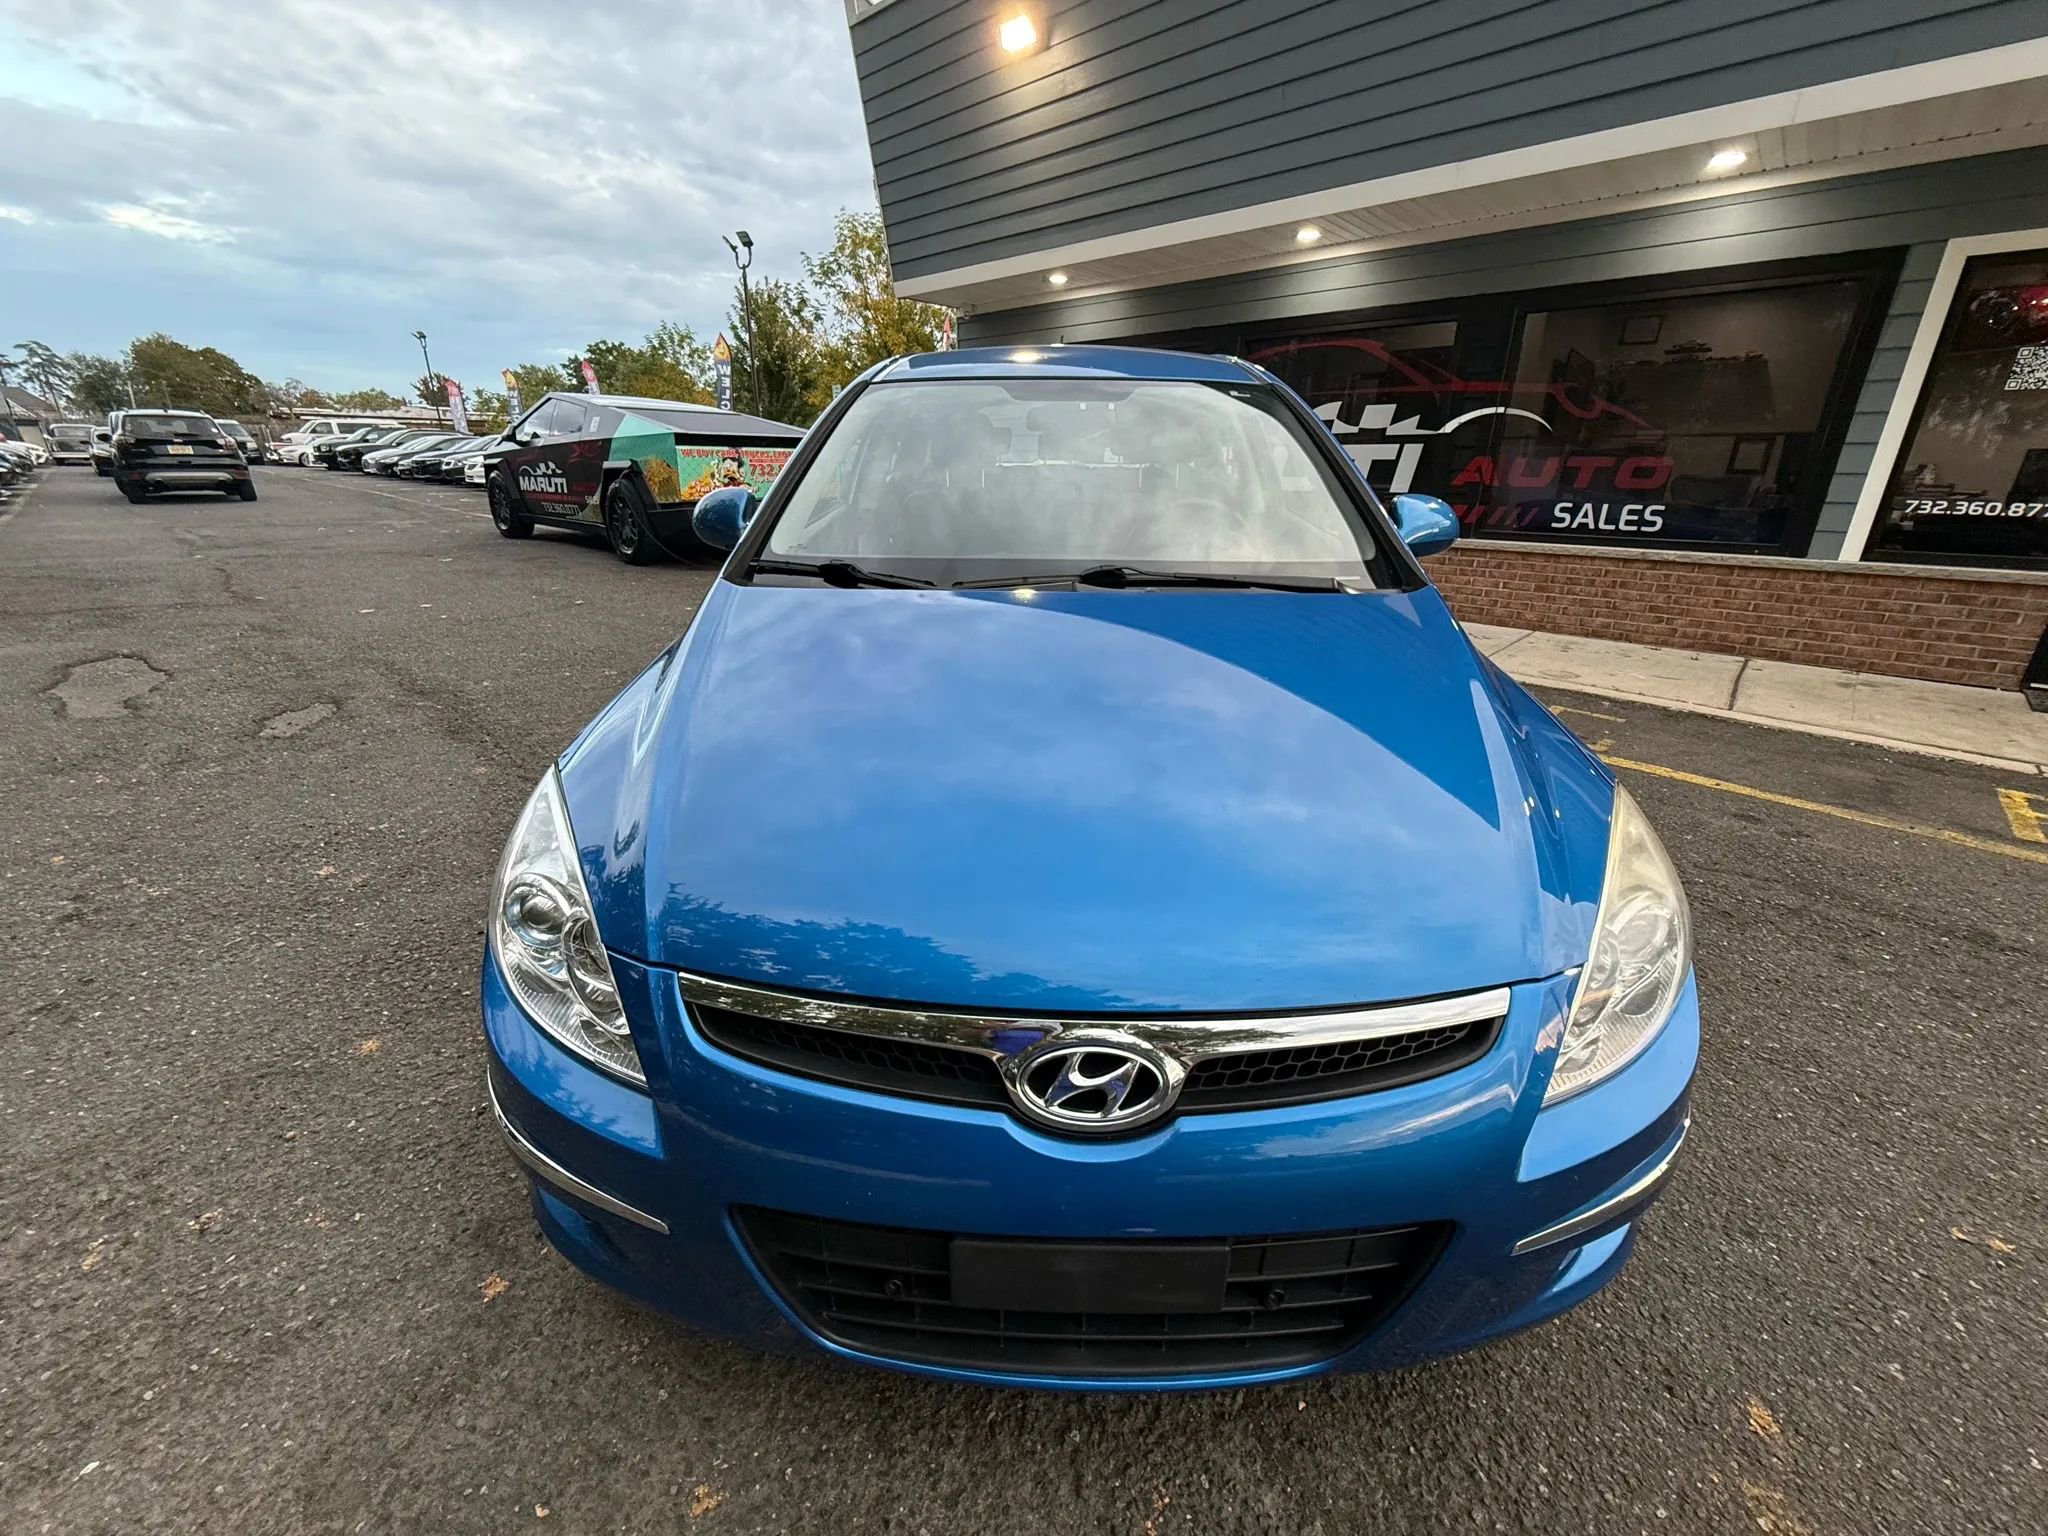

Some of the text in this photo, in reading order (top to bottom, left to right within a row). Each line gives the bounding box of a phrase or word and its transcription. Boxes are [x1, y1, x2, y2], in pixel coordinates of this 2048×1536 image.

[519, 475, 568, 494] MARUTI
[1451, 456, 1675, 490] AUTO
[1551, 502, 1666, 532] SALES
